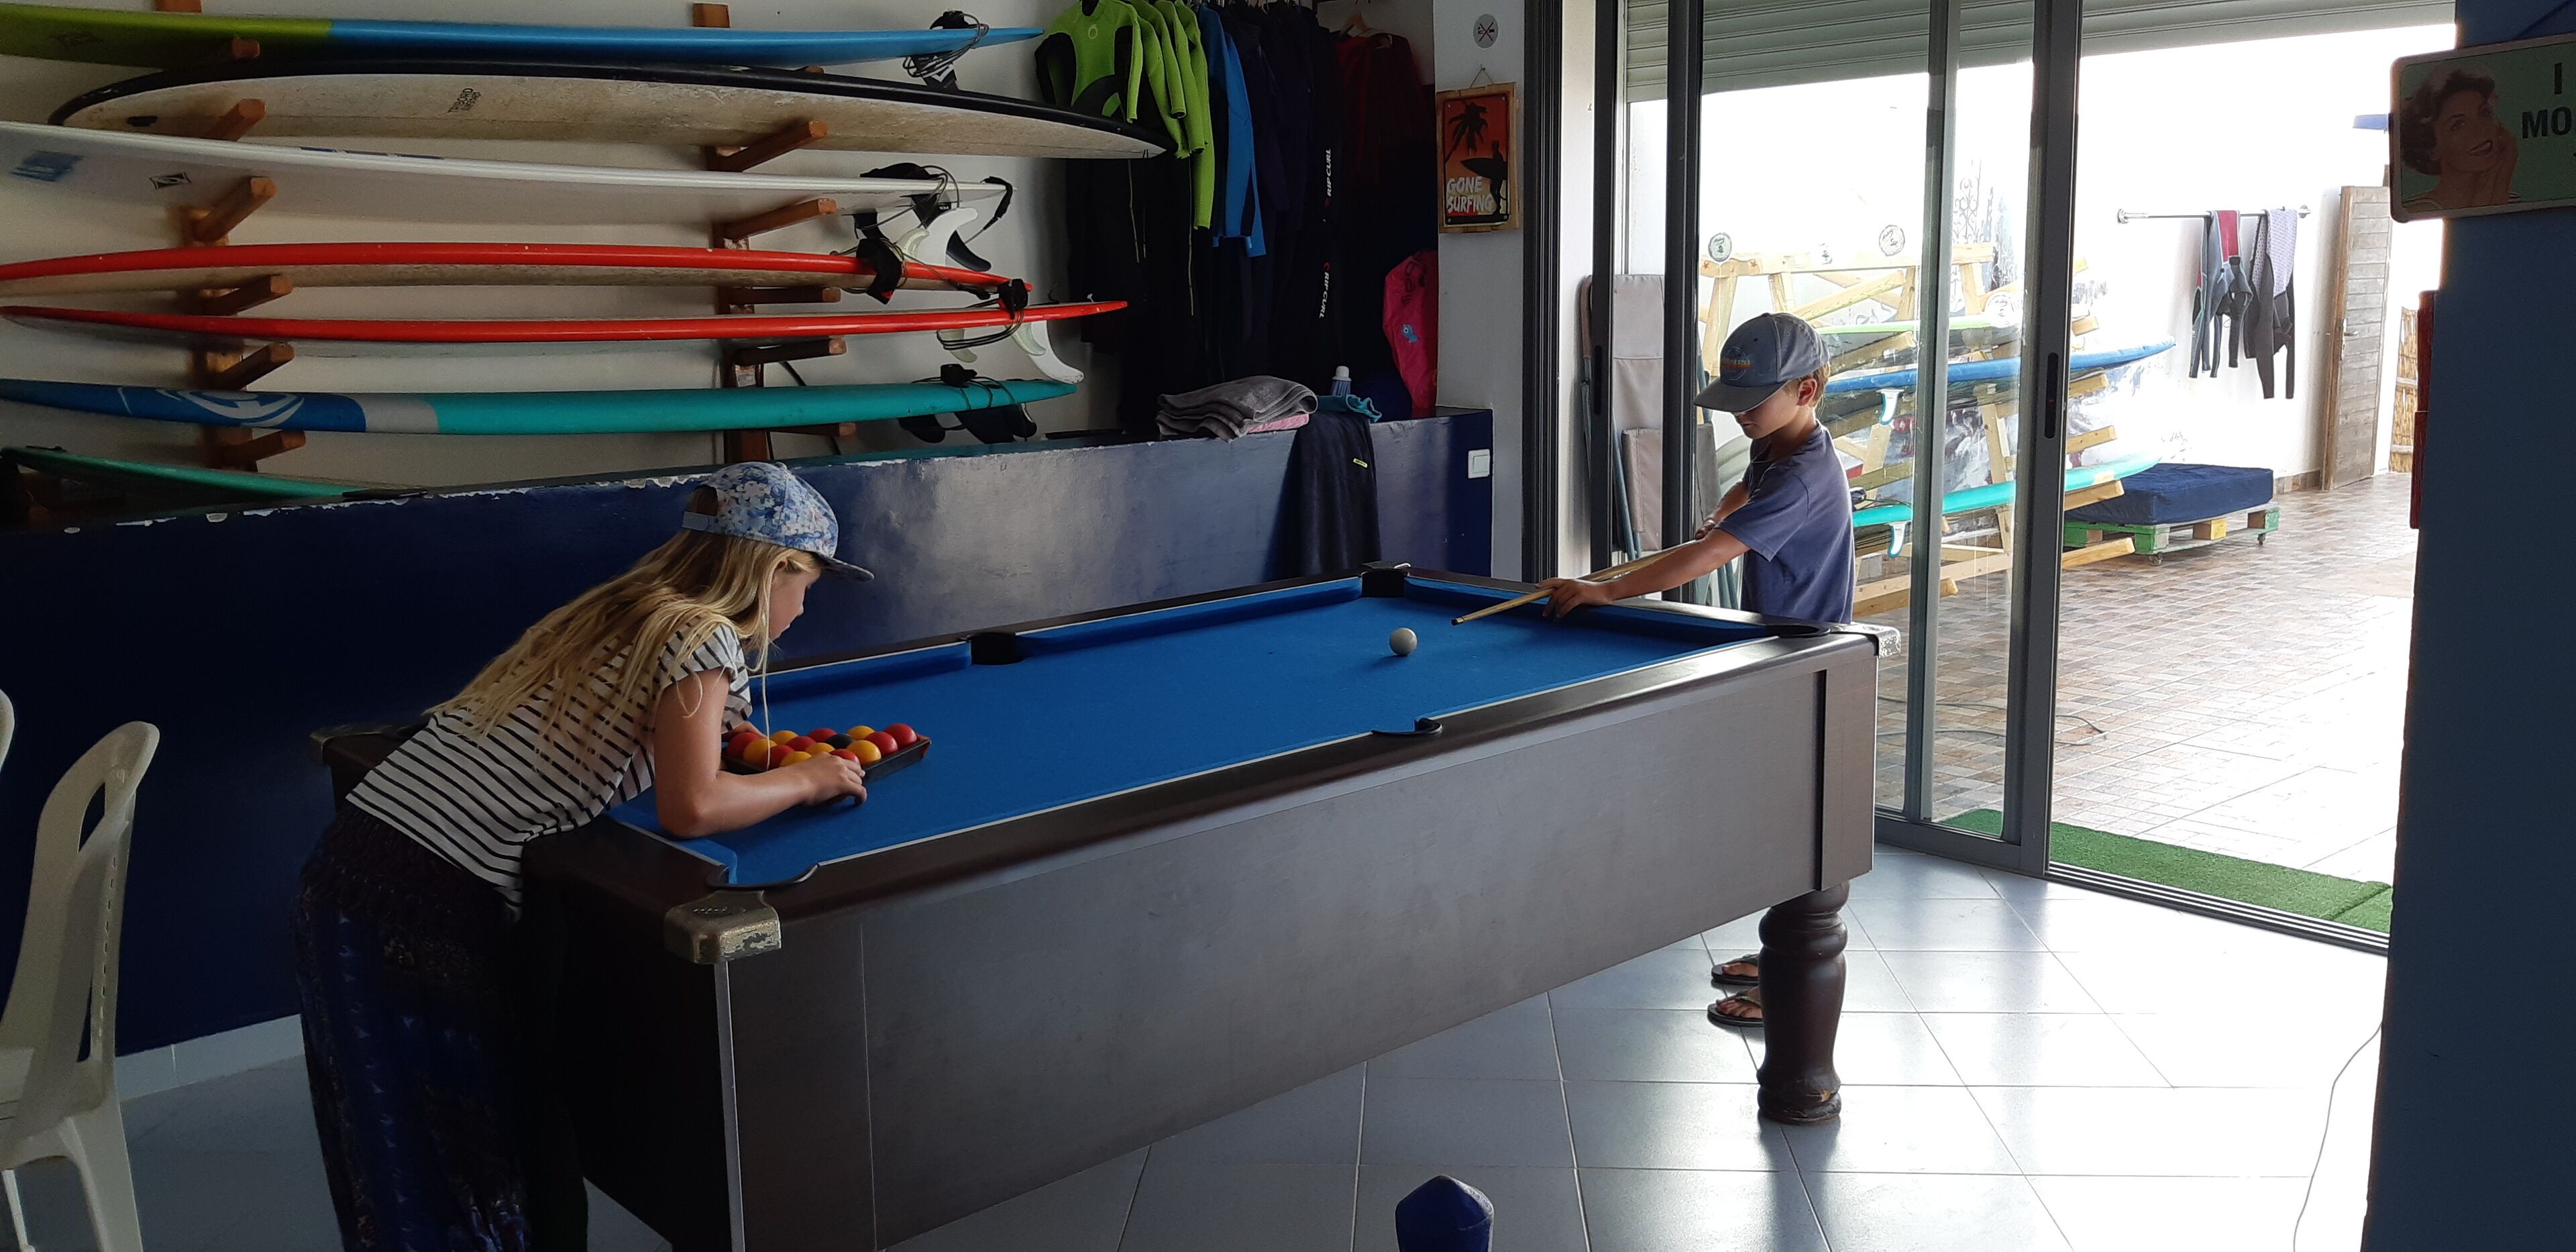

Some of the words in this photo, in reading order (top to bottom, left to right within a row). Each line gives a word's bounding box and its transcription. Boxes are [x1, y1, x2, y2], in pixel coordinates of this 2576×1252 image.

[2554, 62, 2563, 95] I
[2522, 106, 2576, 139] MO
[1446, 176, 1483, 195] GONE
[1446, 193, 1495, 213] SURFING
[1319, 291, 1328, 319] CURL
